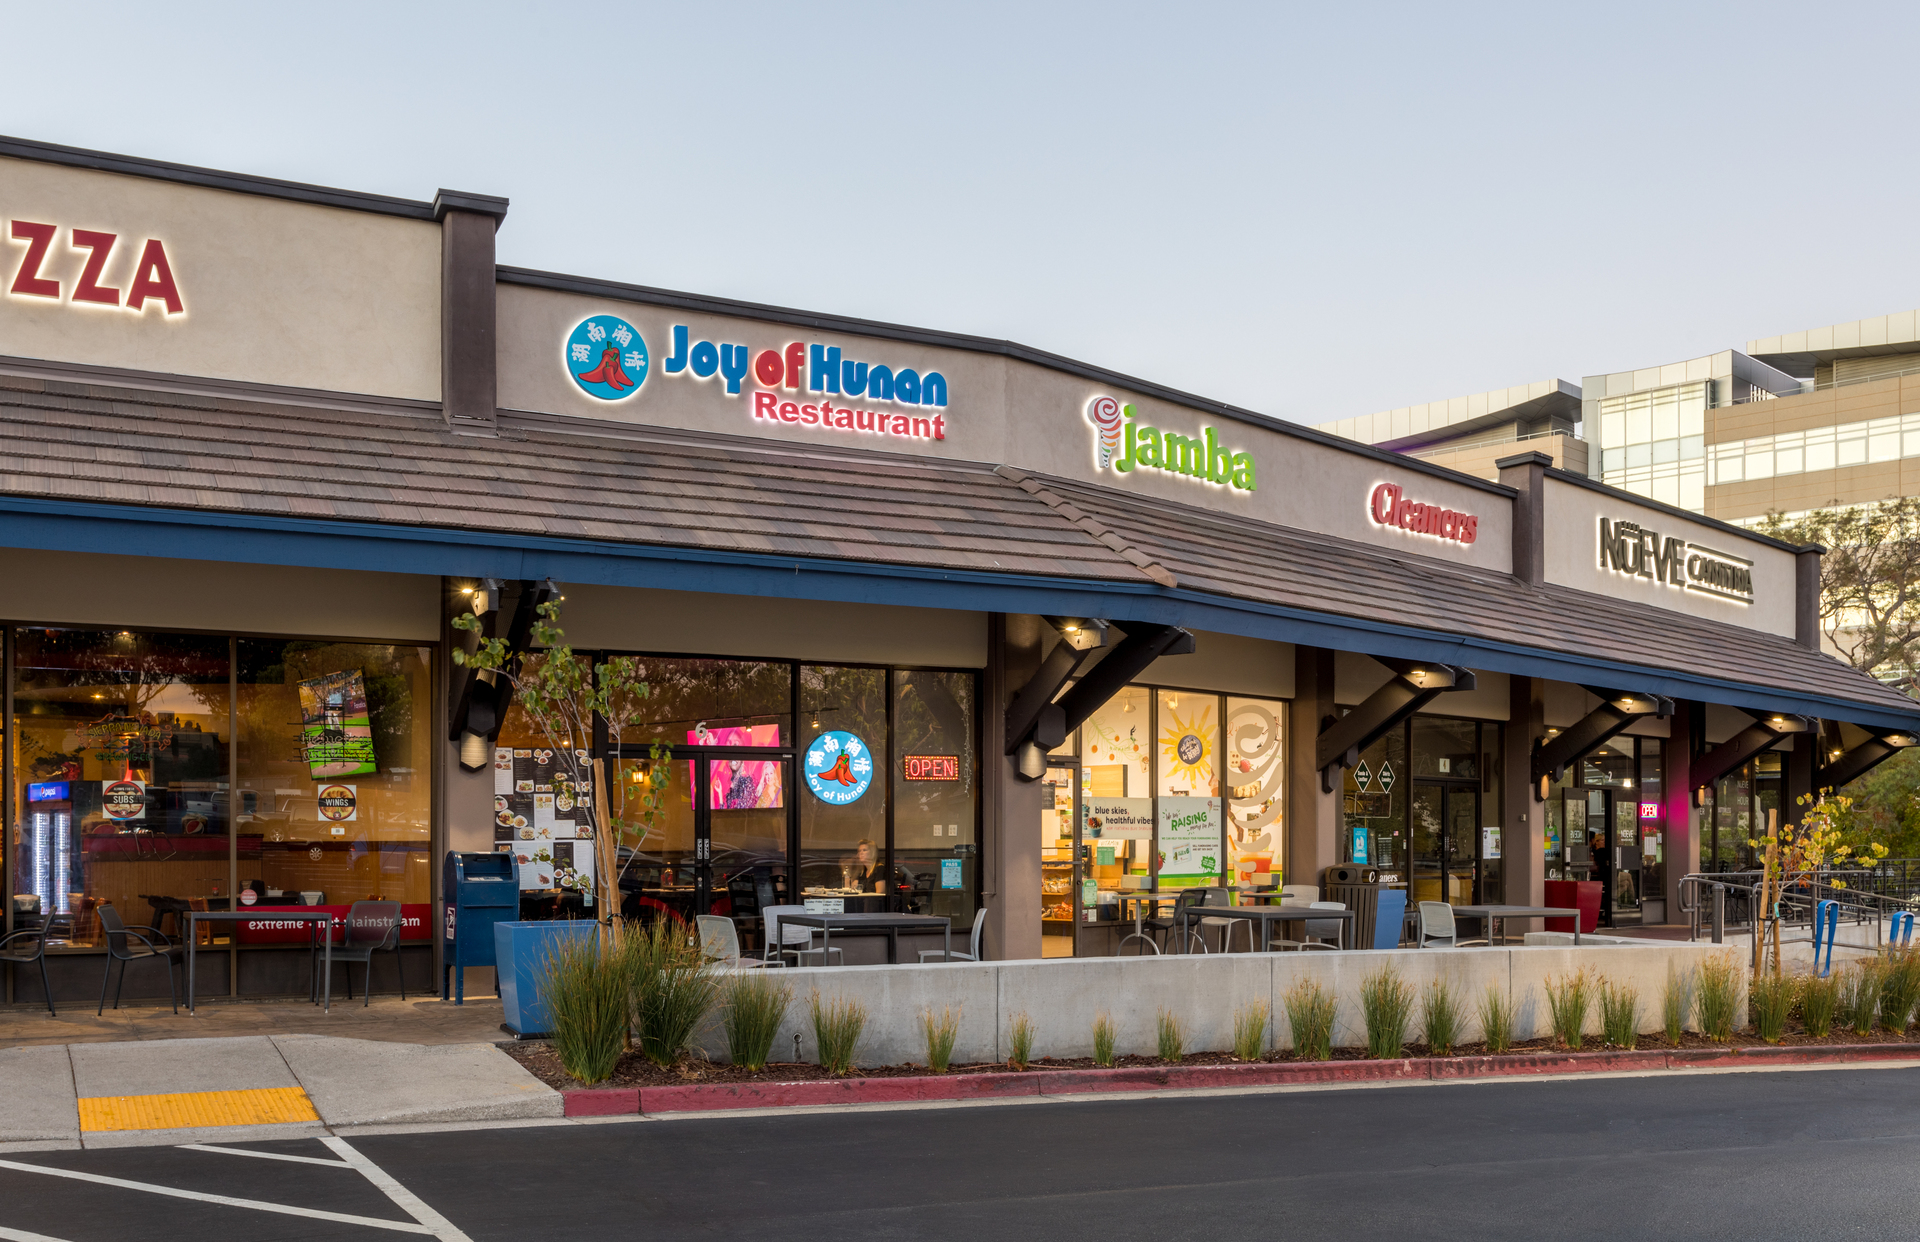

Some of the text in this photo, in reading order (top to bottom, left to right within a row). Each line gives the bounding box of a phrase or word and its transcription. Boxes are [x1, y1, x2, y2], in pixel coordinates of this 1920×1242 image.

[665, 324, 948, 407] Joy of Hunan
[754, 391, 946, 440] Restaurant
[1115, 403, 1258, 492] jamba
[1371, 482, 1478, 544] Cleaners
[1687, 553, 1754, 595] CANTINA
[88, 722, 162, 740] SIERRA NEVADA
[694, 721, 708, 740] 6
[909, 759, 955, 777] OPEN
[1608, 771, 1613, 782] 2
[808, 773, 867, 801] Joy of Hunan
[113, 795, 134, 804] SUBS
[325, 799, 349, 807] WINGS
[1095, 806, 1130, 816] blue skies,
[1105, 816, 1155, 824] healthful vibes
[1642, 805, 1656, 817] OPEN
[1171, 811, 1208, 831] RAISING
[1368, 871, 1399, 883] Caners
[248, 920, 304, 931] extreme
[317, 917, 340, 929] nt
